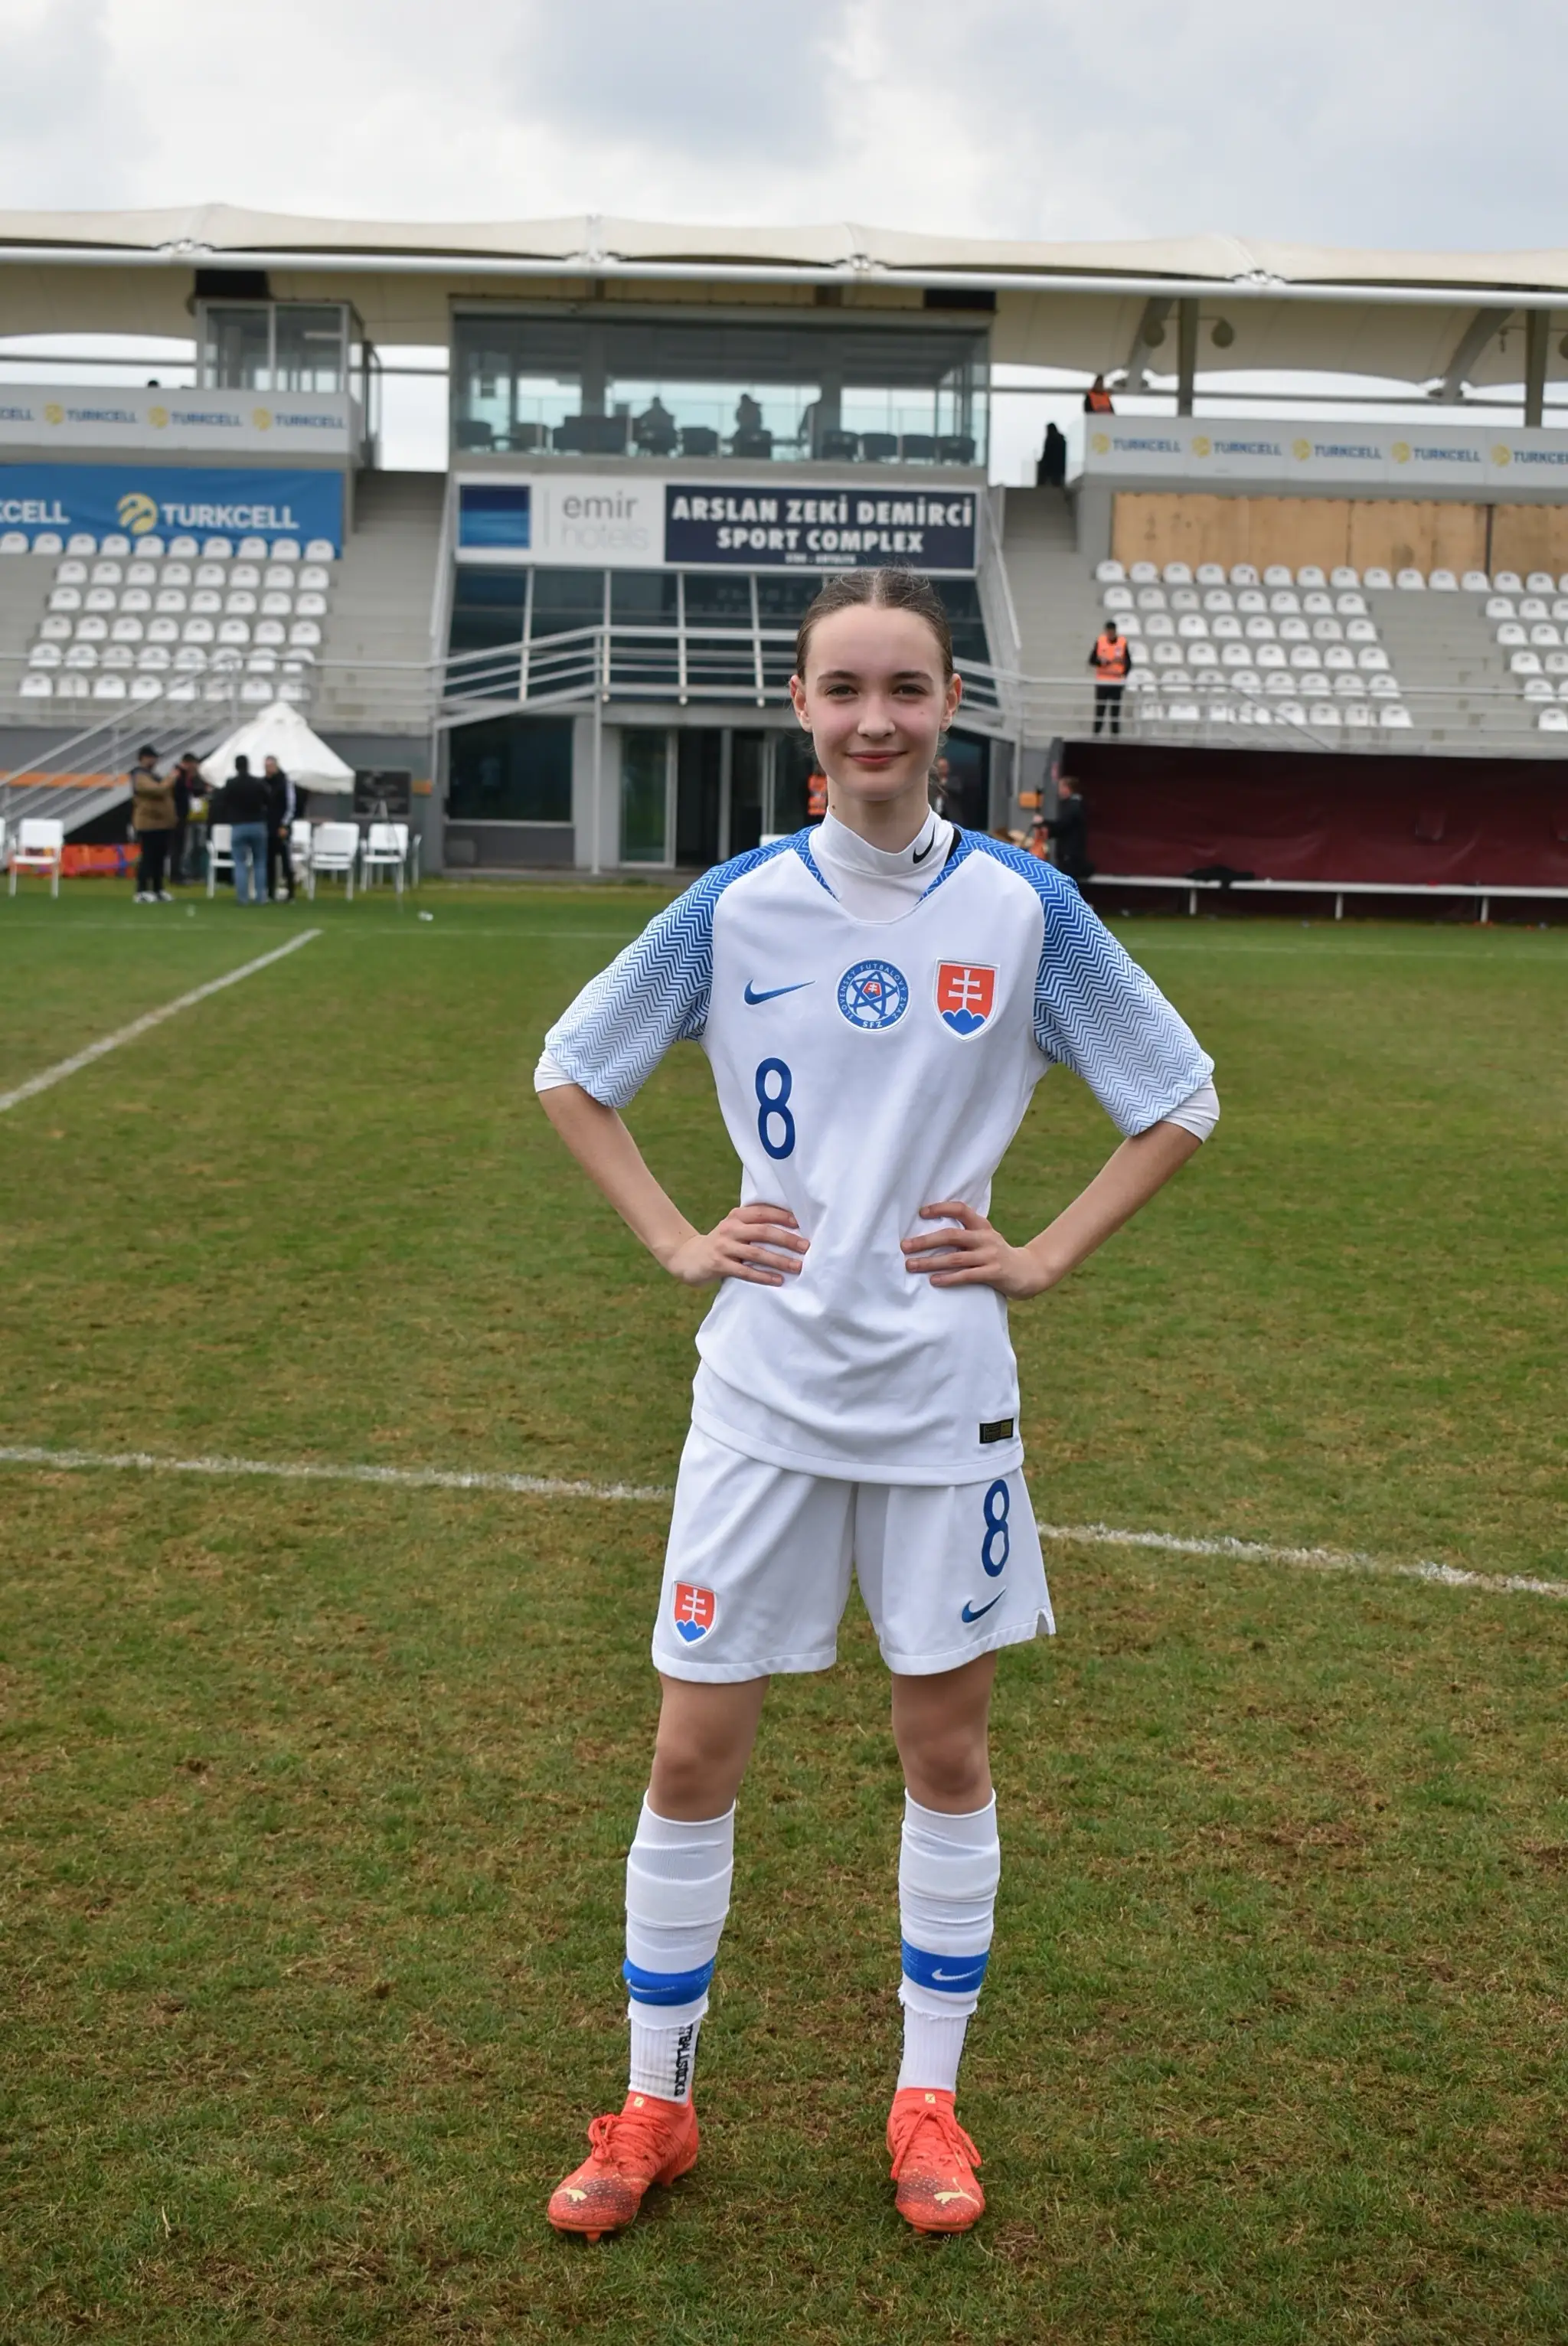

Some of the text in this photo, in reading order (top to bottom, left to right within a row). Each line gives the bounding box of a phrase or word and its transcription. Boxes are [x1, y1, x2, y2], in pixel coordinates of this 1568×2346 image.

[66, 408, 139, 423] TURKCELL
[171, 412, 243, 427] TURKCELL
[276, 413, 346, 429] TURKCELL
[1112, 437, 1181, 453] TURKCELL
[1214, 441, 1282, 456] TURKCELL
[1314, 444, 1382, 459] TURKCELL
[1413, 446, 1481, 462] TURKCELL
[562, 489, 639, 520] emir
[671, 494, 972, 528] ARSLAN ZEKİ DEMİRCİ
[161, 503, 300, 530] TURKCELL
[717, 527, 924, 554] SPORT COMPLEX
[755, 1057, 796, 1160] 8
[982, 1479, 1011, 1578] 8
